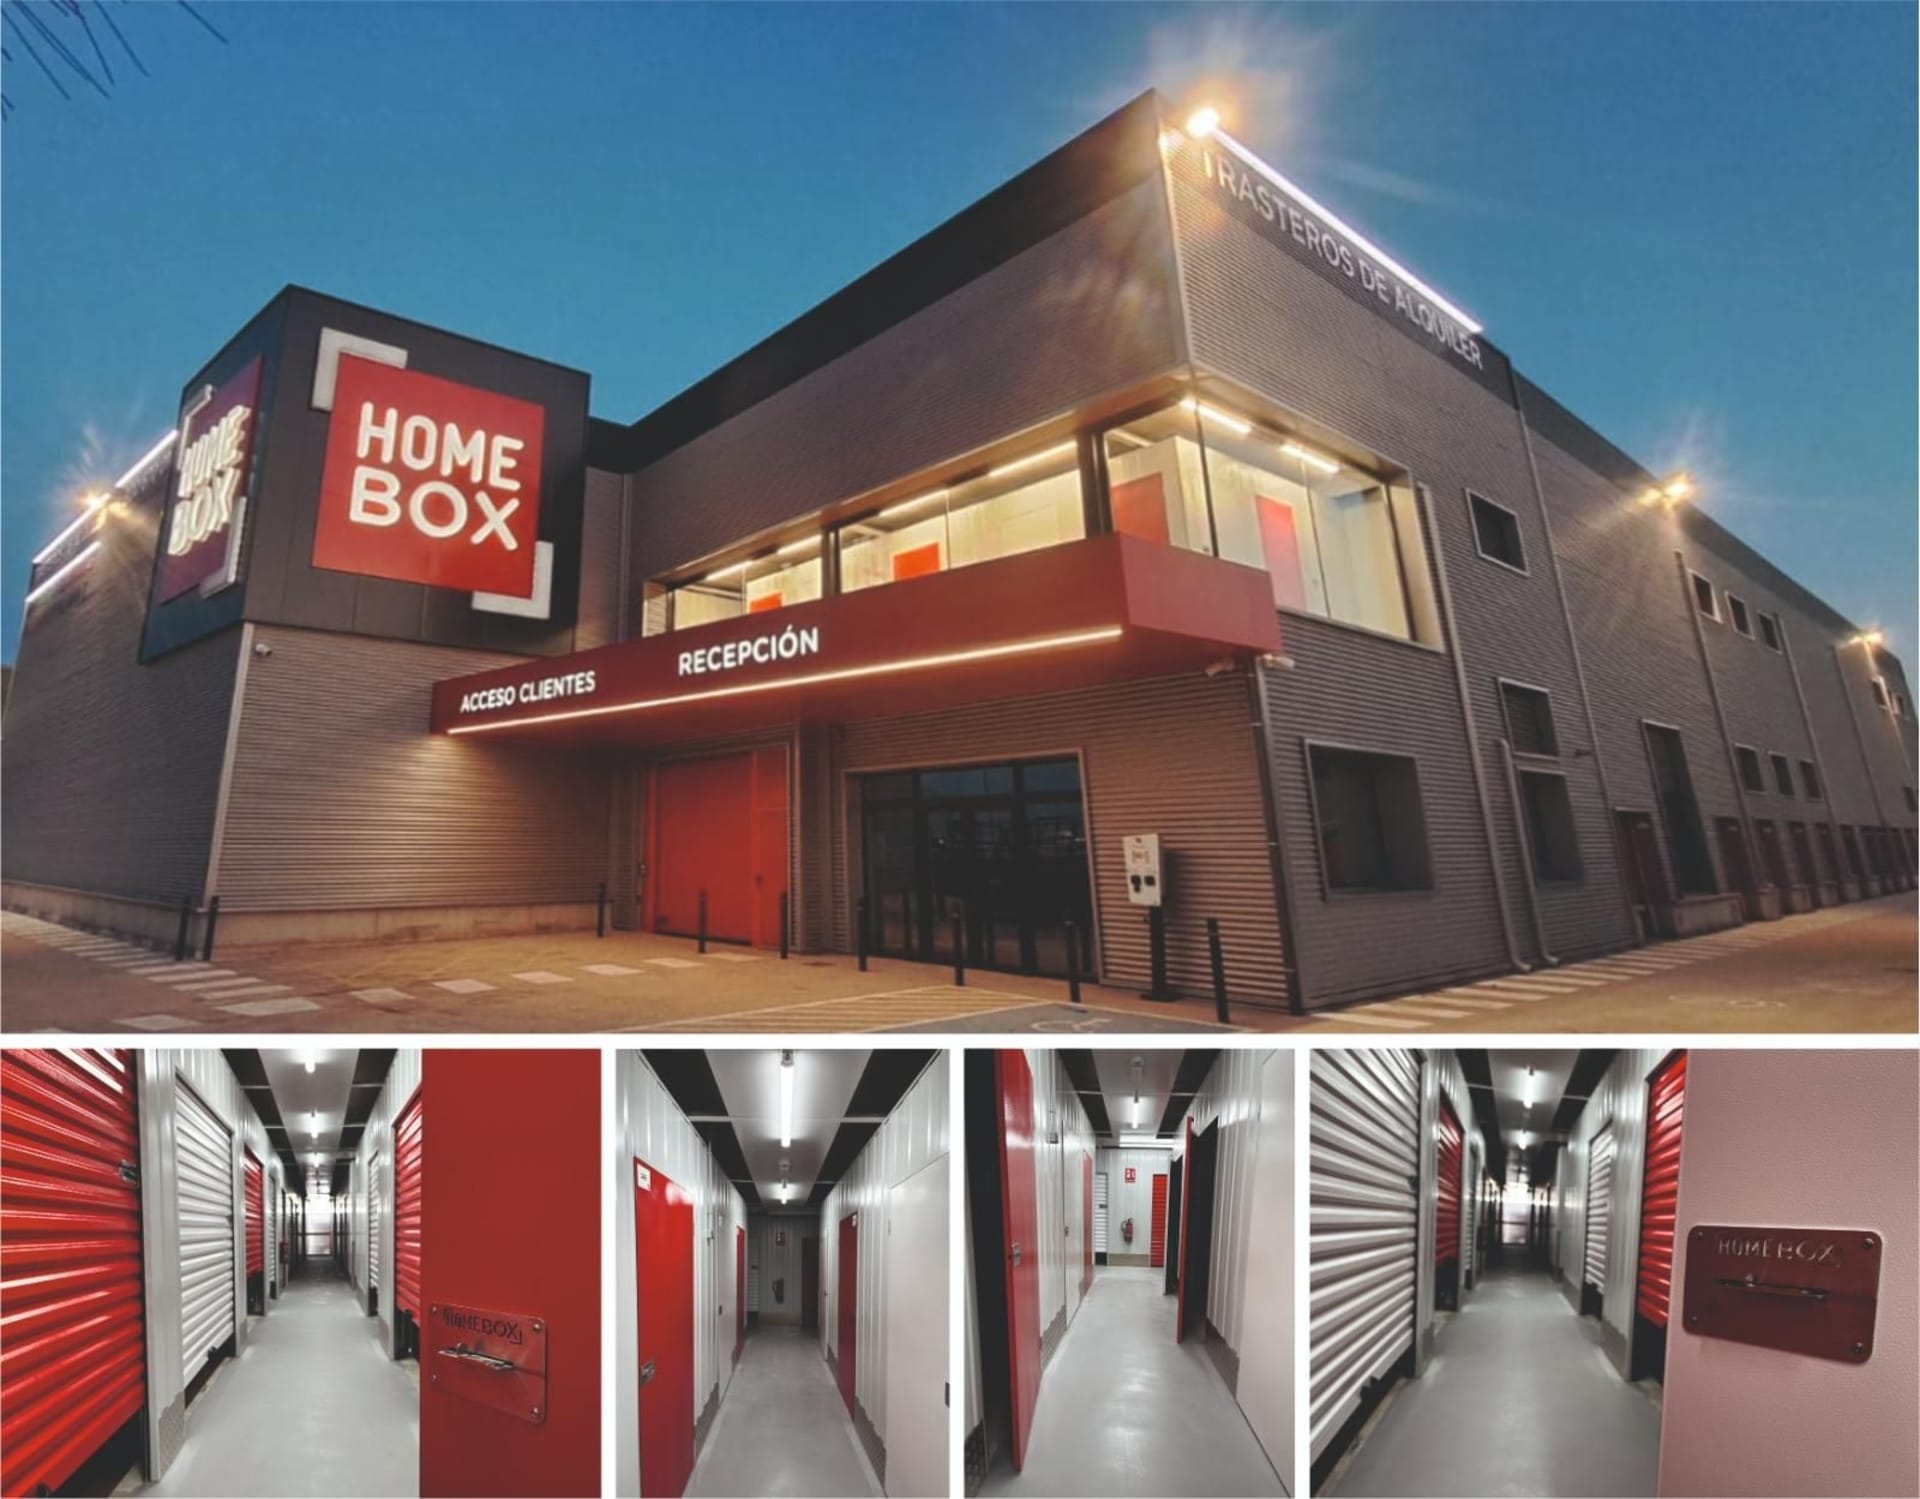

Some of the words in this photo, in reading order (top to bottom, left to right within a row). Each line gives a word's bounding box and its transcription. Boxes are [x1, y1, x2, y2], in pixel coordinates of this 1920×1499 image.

[1358, 258, 1389, 303] DE
[1394, 284, 1484, 371] ALQUILER
[177, 404, 252, 498] HOME
[356, 401, 525, 492] HOME
[167, 467, 242, 556] BOX
[349, 464, 521, 551] BOX
[459, 685, 517, 714] ACCESO
[518, 669, 597, 704] CLIENTES
[678, 625, 820, 677] RECEPCIÓN
